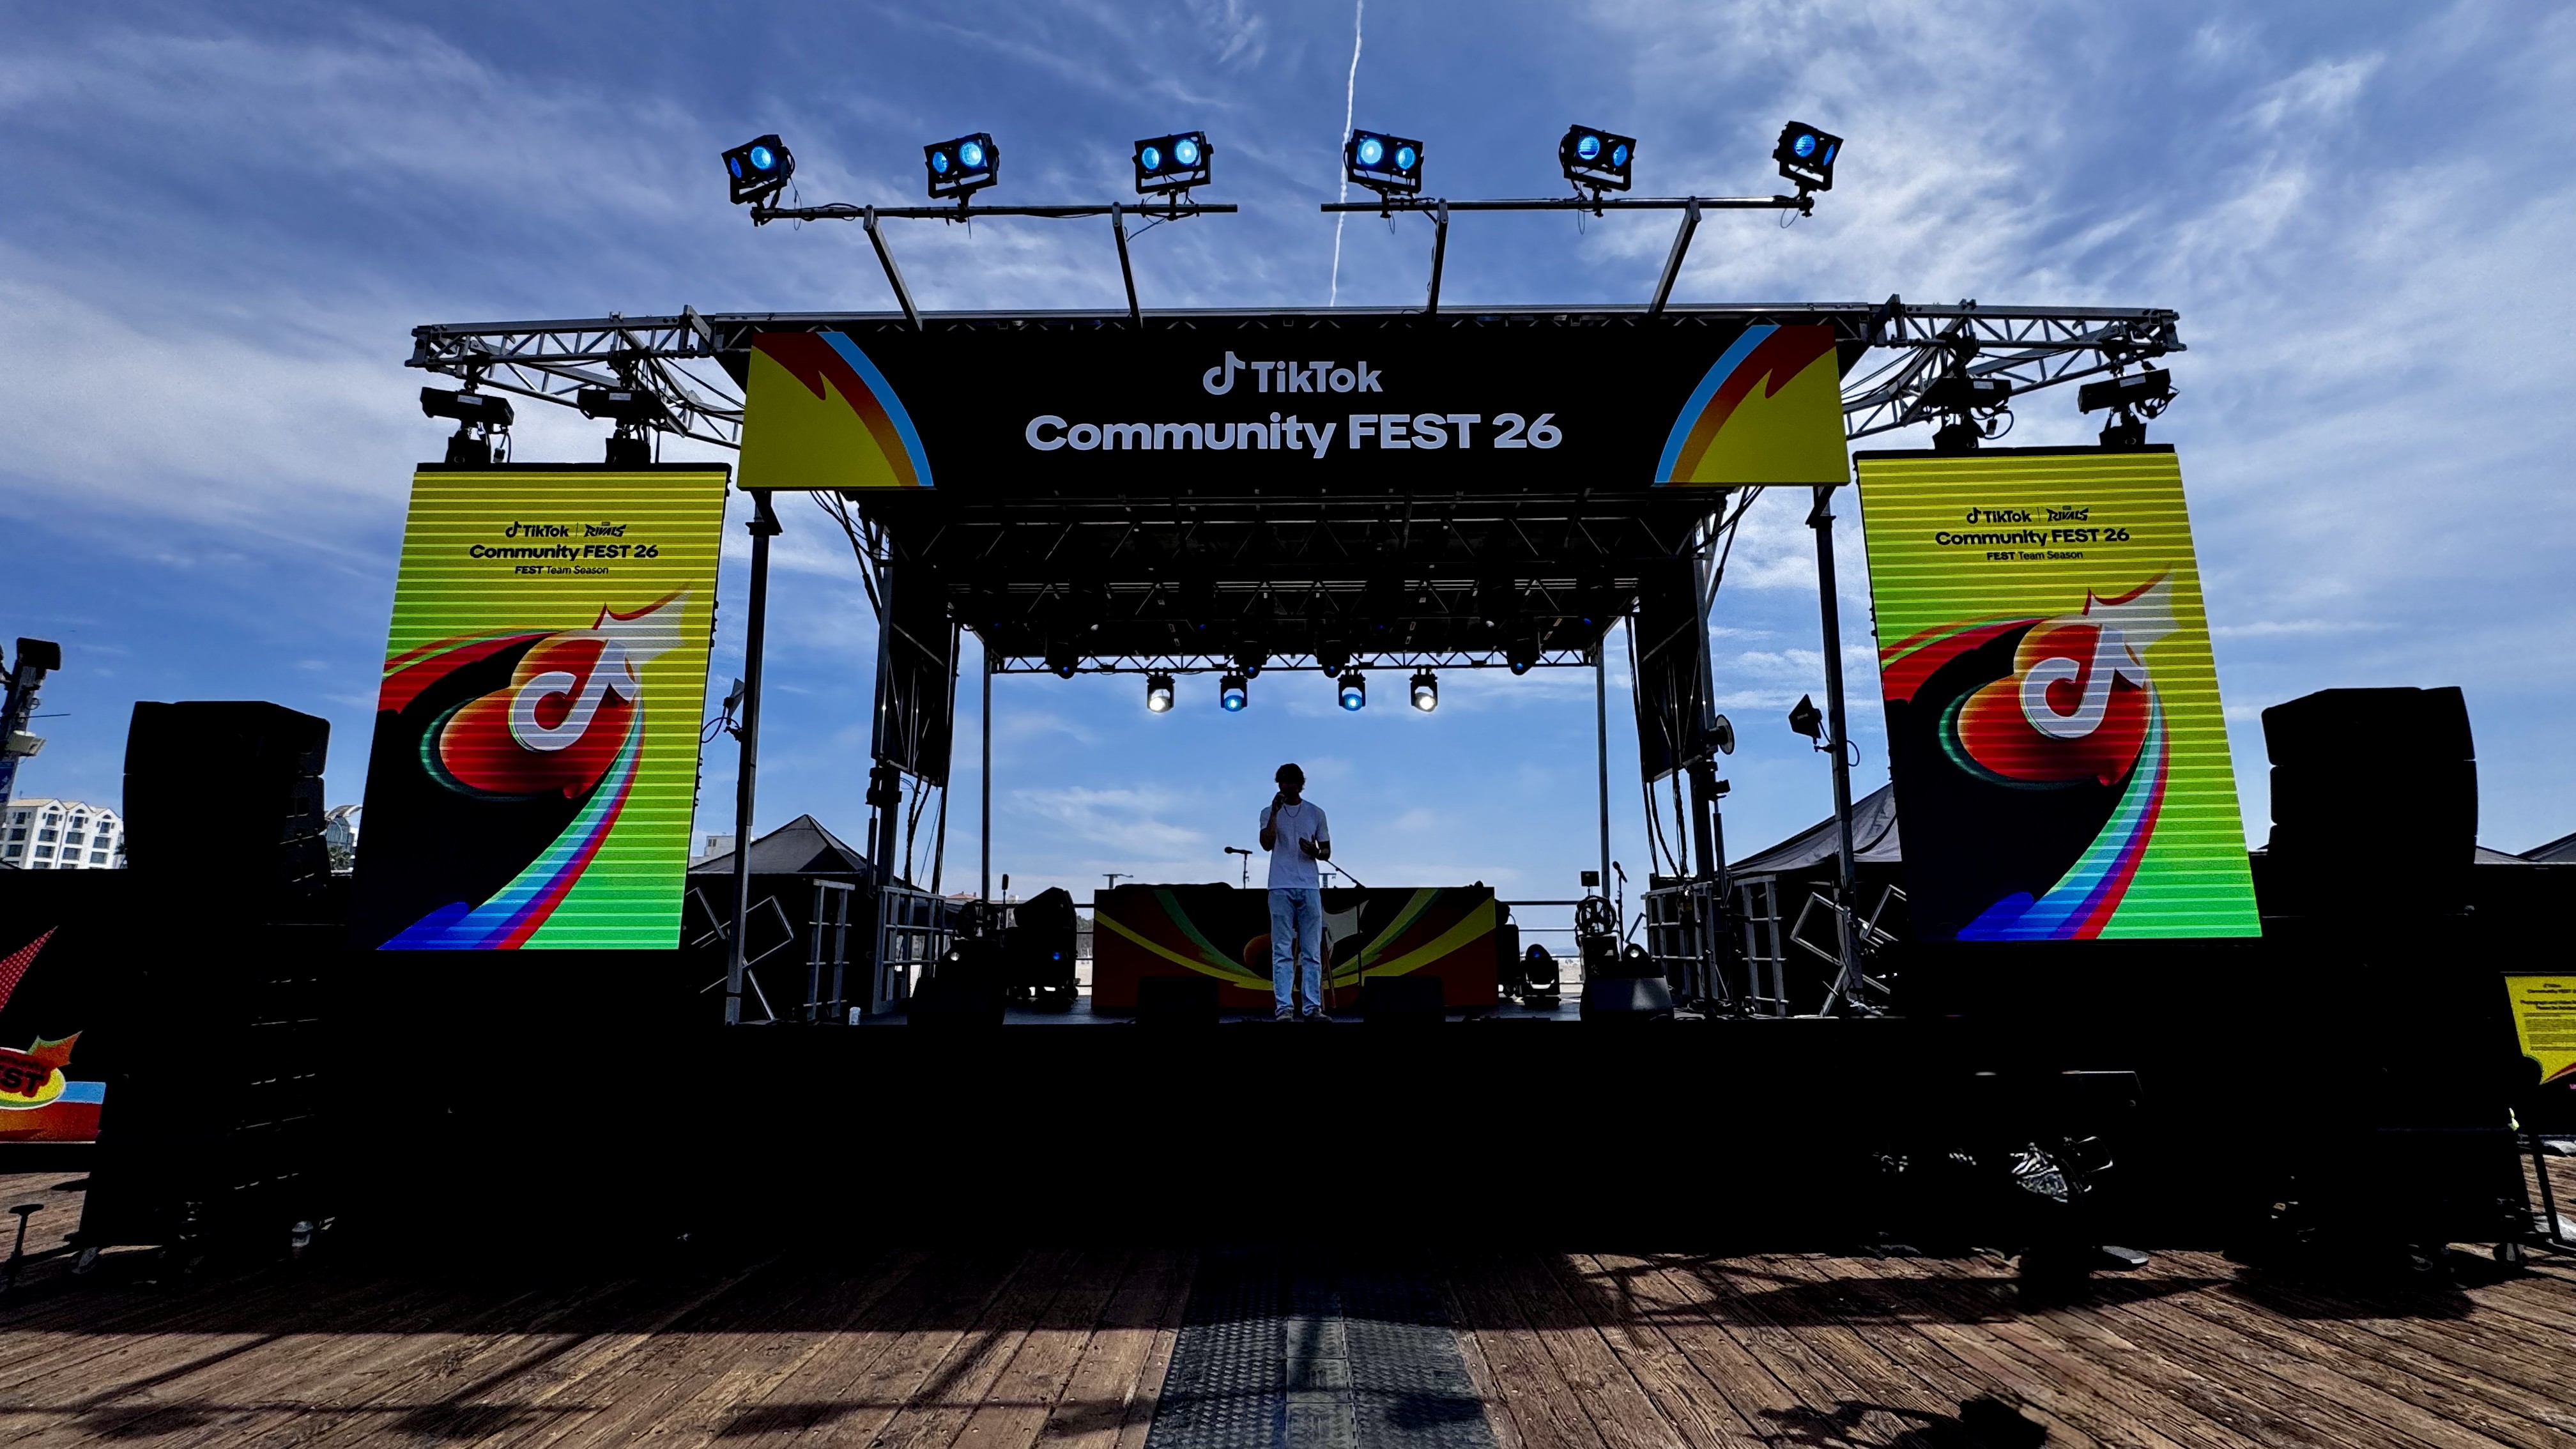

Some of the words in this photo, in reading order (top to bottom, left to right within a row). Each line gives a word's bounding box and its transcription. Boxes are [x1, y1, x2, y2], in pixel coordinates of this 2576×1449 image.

[1251, 360, 1383, 393] TikTok
[1025, 411, 1337, 459] Community
[1349, 413, 1481, 450] FEST
[1492, 413, 1563, 449] 26
[1983, 509, 2032, 523] TikTok
[2046, 507, 2089, 522] RIVALS
[523, 525, 569, 537] TikTok
[584, 523, 627, 537] RIVALS
[1935, 529, 2048, 546] Community
[2051, 528, 2100, 543] FEST
[2104, 527, 2130, 542] 26
[469, 544, 580, 562] Community
[583, 544, 631, 558] FEST
[633, 544, 659, 558] 26
[1986, 551, 2016, 560] FEST
[2018, 551, 2044, 560] Team
[2046, 550, 2083, 560] Season
[514, 565, 544, 574] FEST
[546, 565, 572, 574] Team
[573, 565, 609, 574] Season
[0, 1064, 44, 1092] ST
